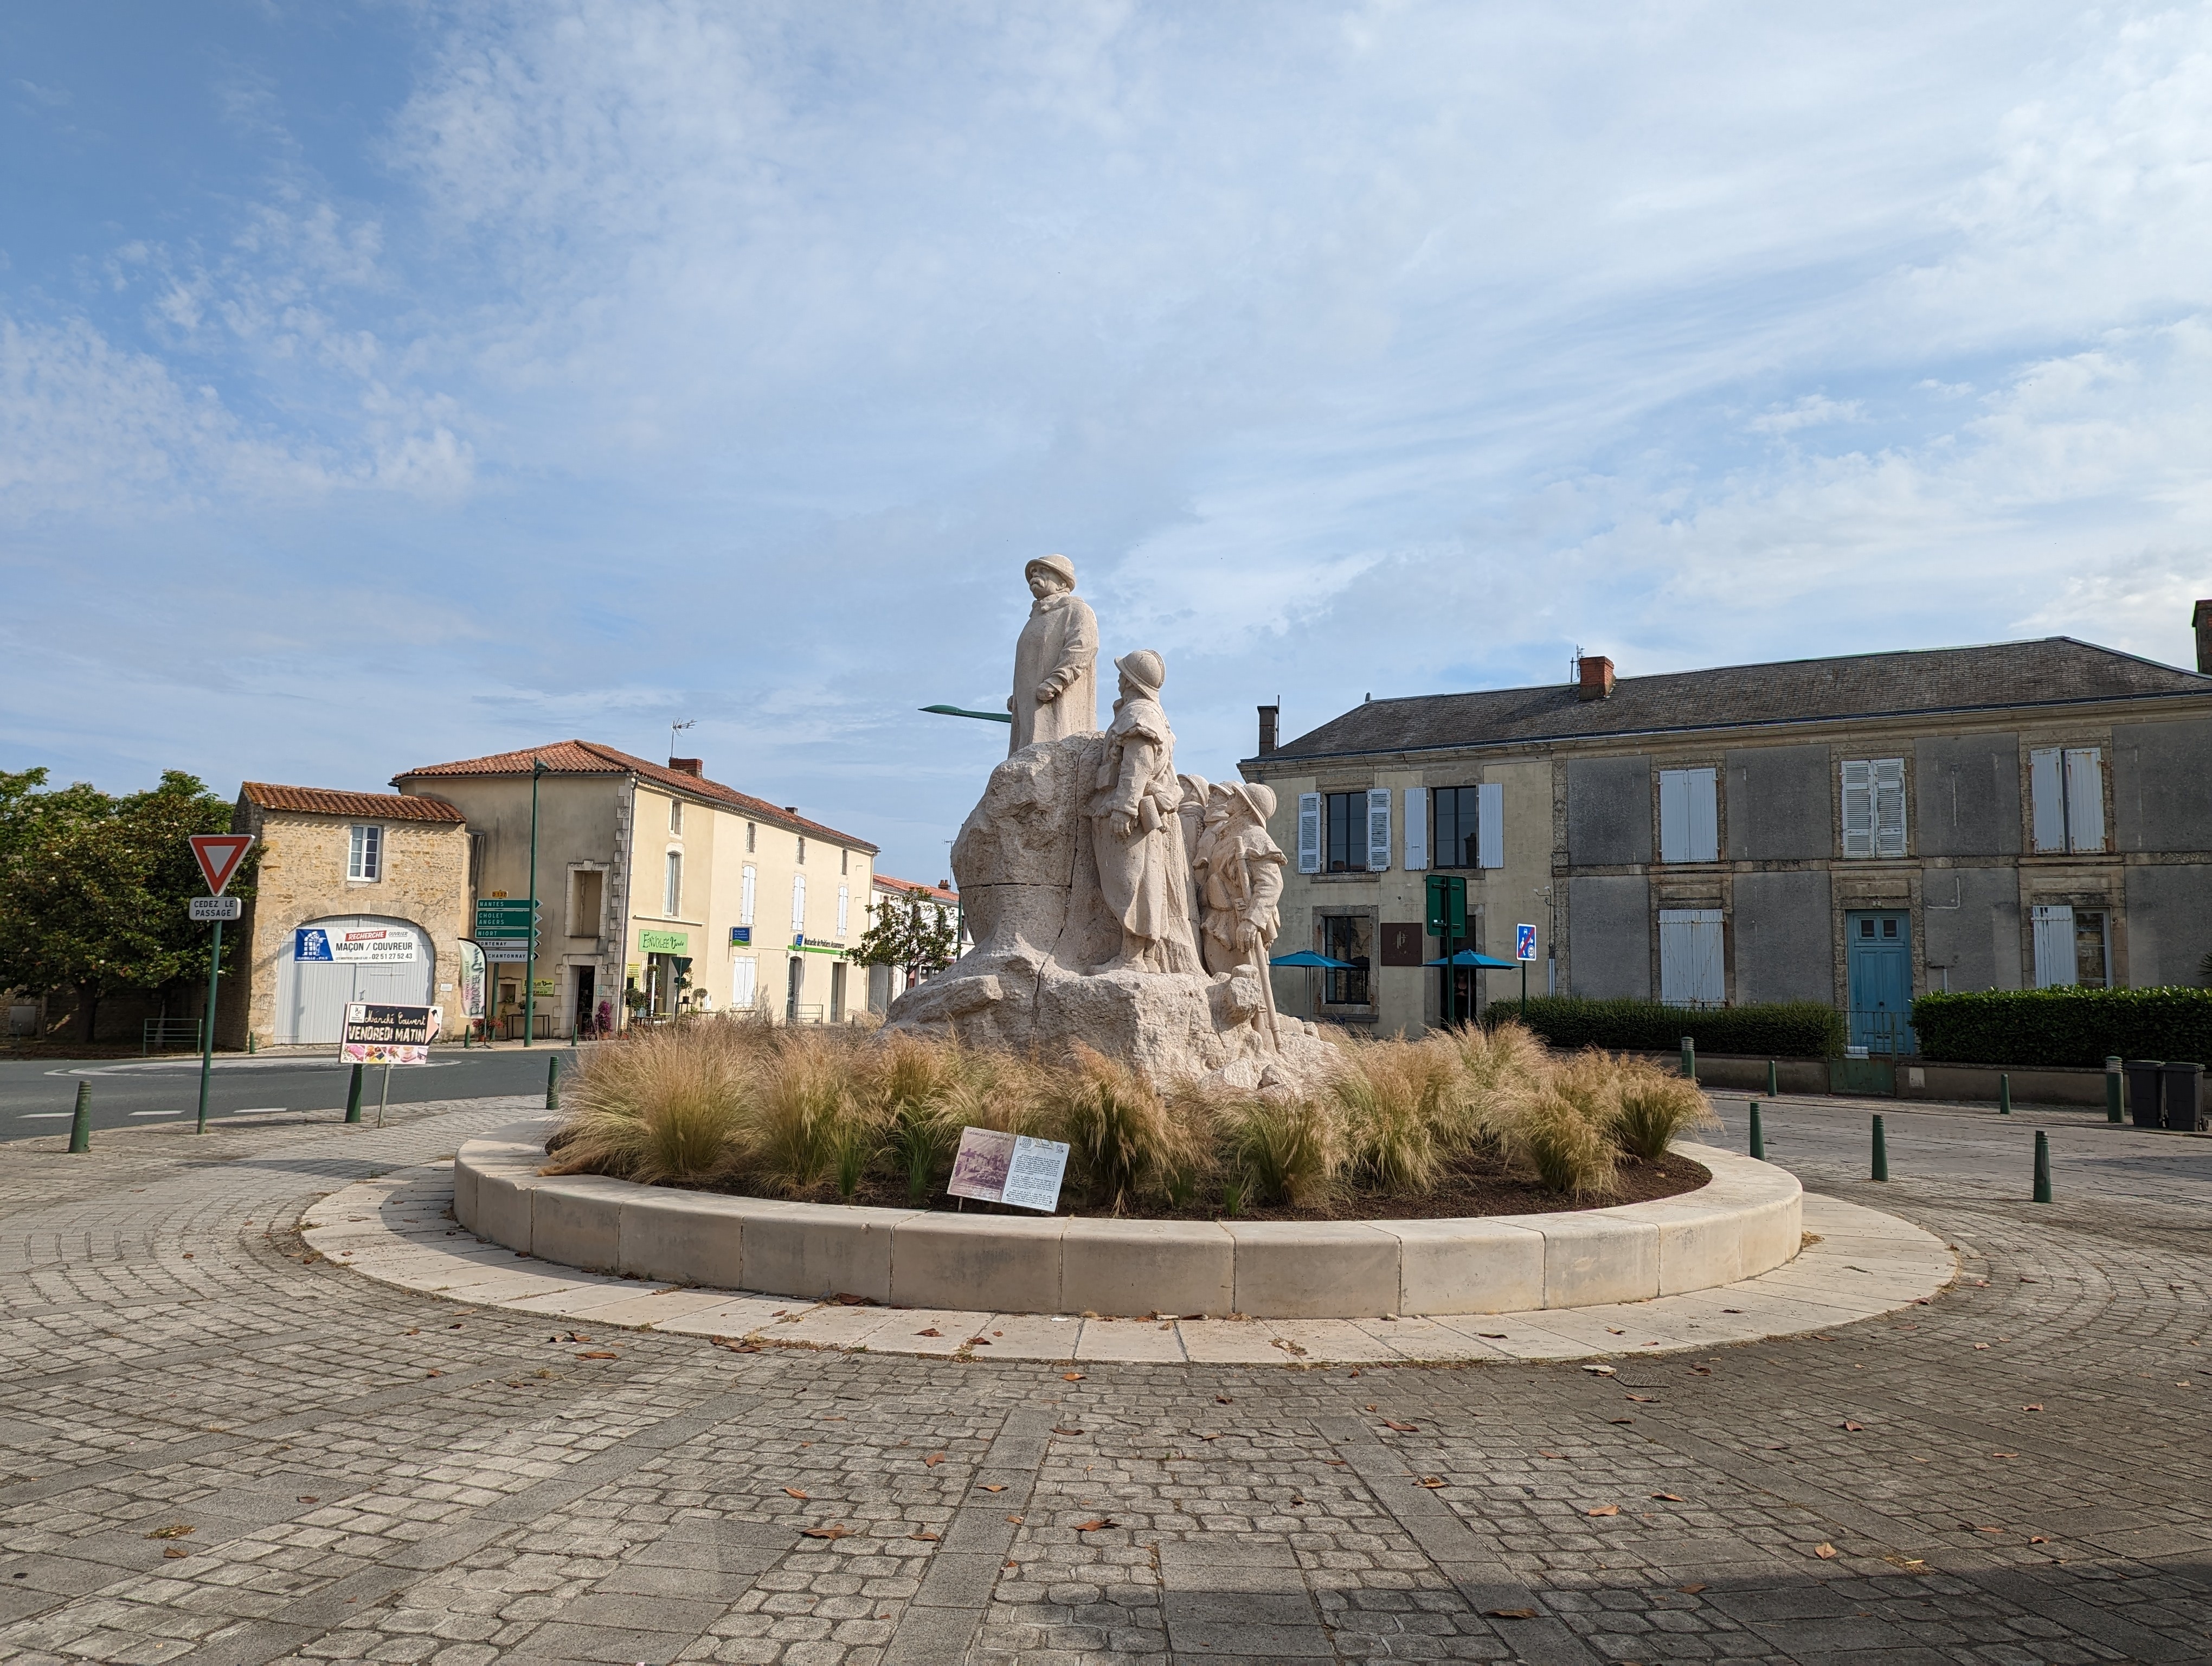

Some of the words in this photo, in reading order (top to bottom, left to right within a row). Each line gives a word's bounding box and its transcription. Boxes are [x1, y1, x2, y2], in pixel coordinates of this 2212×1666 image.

[348, 932, 384, 940] RECHERCHE
[336, 943, 364, 952] MAÇON
[365, 943, 371, 951] /
[372, 942, 413, 951] COUVREUR
[364, 1010, 395, 1024] Marché
[398, 1011, 426, 1026] Couvert
[394, 1028, 426, 1043] MATIN
